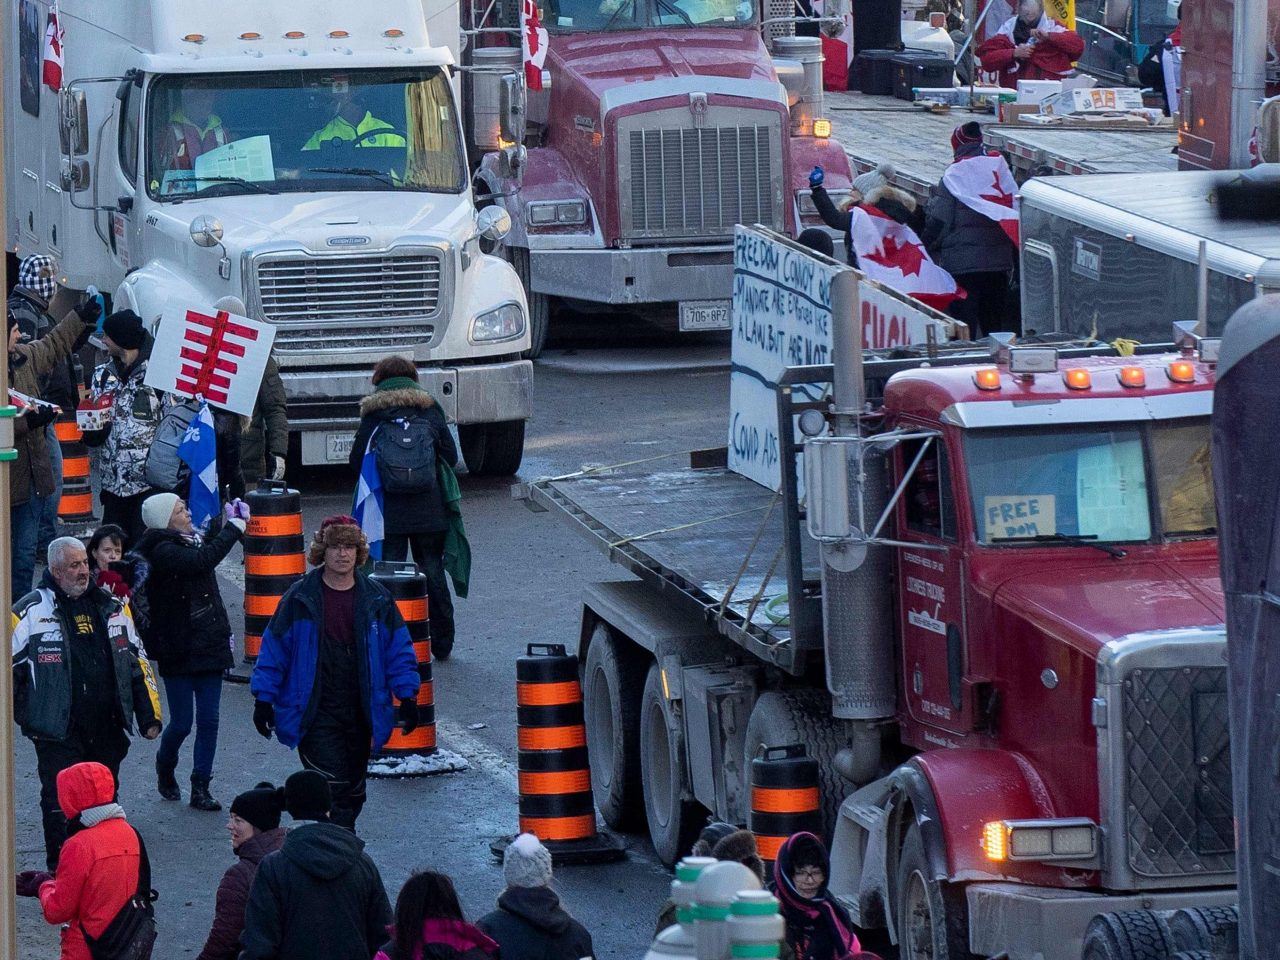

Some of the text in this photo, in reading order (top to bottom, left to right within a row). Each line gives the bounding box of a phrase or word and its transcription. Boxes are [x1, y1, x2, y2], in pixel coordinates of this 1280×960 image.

[988, 499, 1040, 527] FREE
[1005, 522, 1039, 537] DOM
[37, 653, 62, 664] NSK
